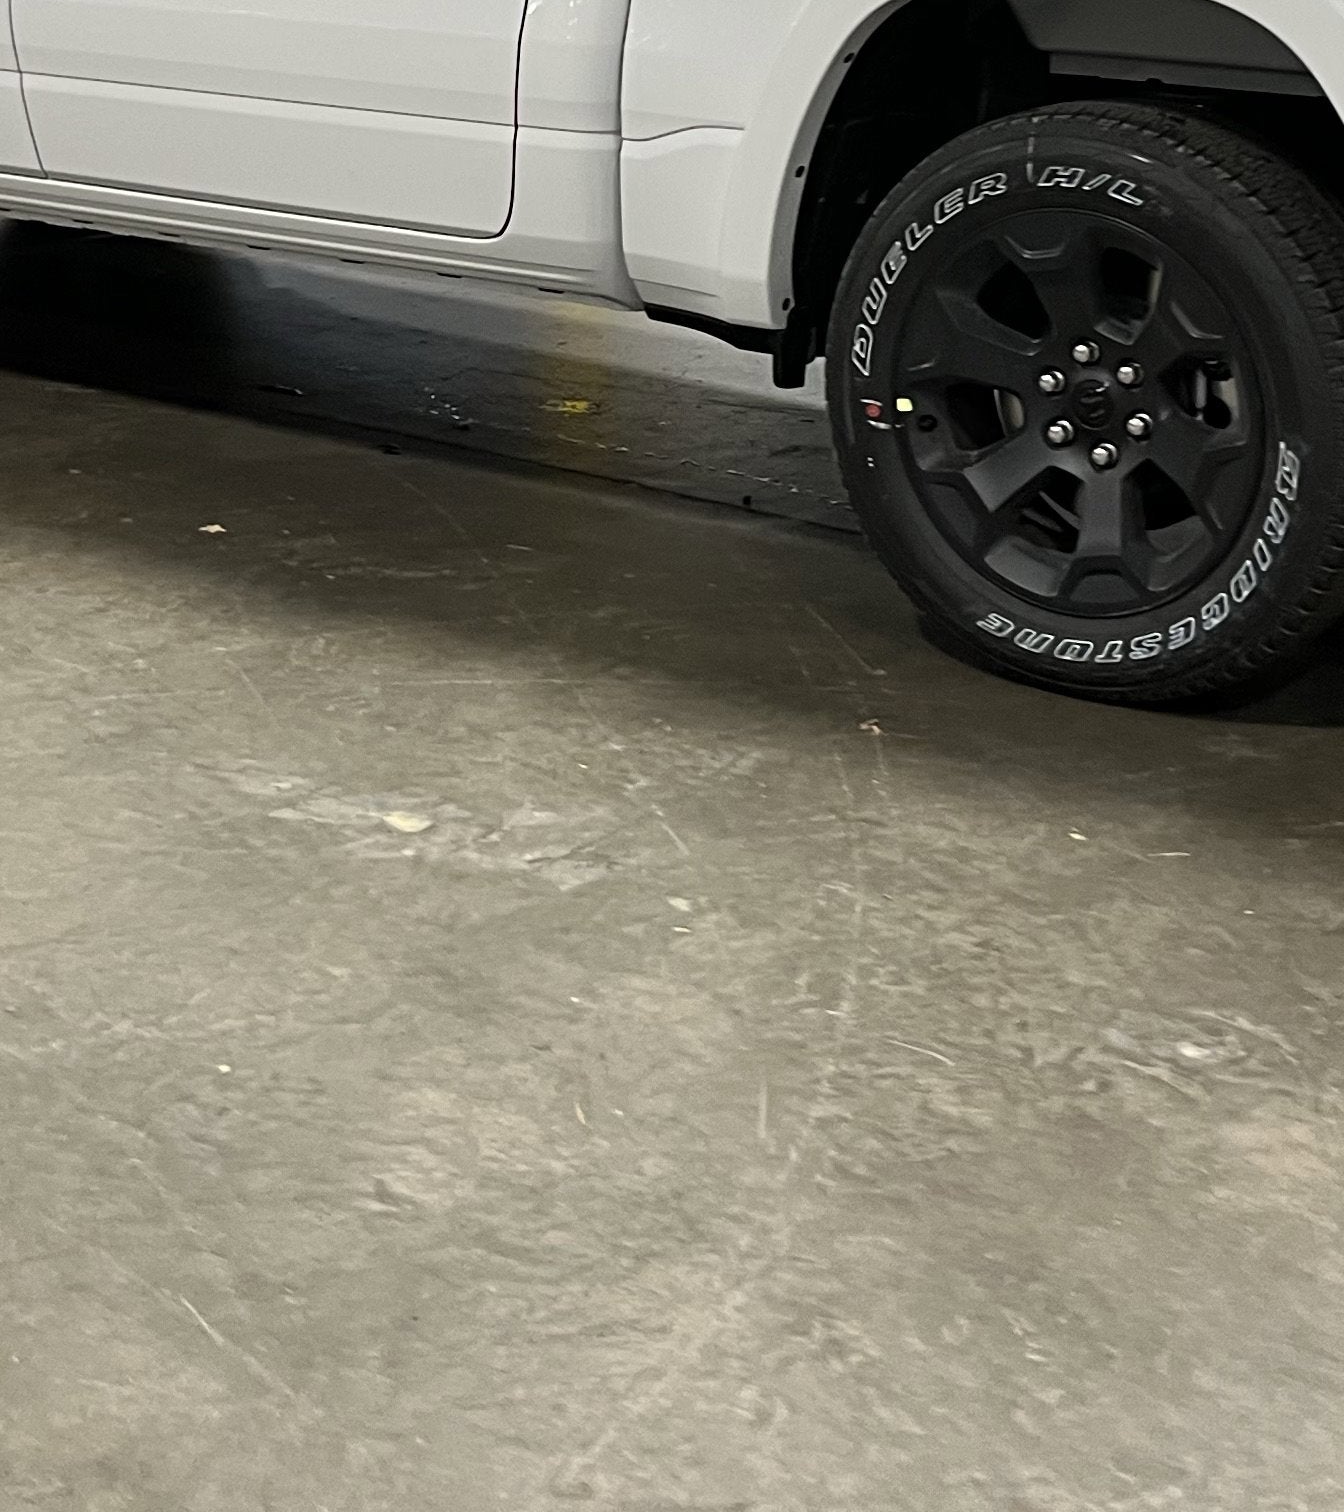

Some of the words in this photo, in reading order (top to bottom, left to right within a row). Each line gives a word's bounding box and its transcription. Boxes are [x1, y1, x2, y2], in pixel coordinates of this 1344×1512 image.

[851, 172, 1008, 376] DUELER
[1037, 166, 1144, 206] H/L
[976, 441, 1301, 663] BRIDGESTONE
